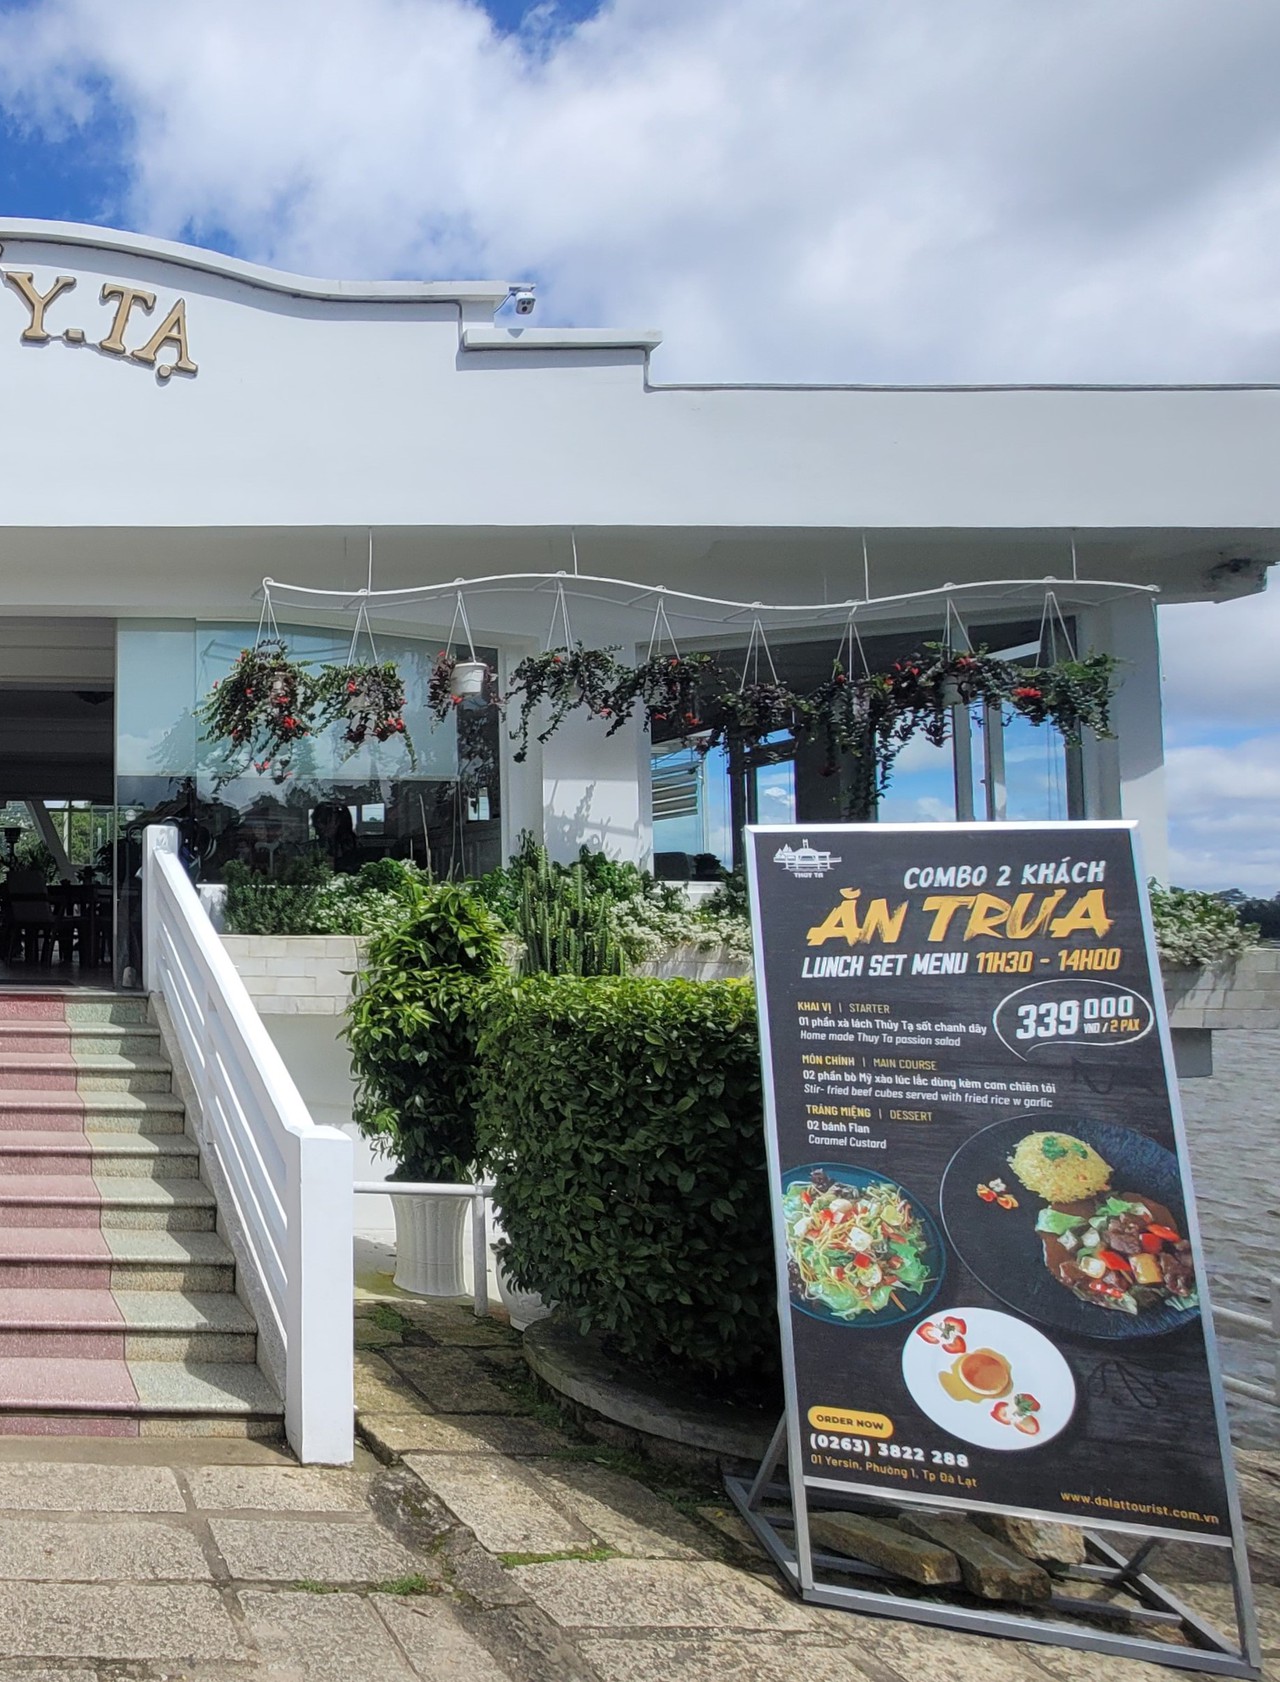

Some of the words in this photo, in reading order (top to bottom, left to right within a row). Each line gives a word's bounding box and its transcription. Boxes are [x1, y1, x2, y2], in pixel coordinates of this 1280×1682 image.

[904, 865, 987, 889] COMBO
[996, 866, 1012, 885] 2
[1021, 857, 1106, 885] KHÁCH
[806, 887, 910, 946] ĂN
[801, 955, 864, 978] LUNCH
[868, 953, 908, 976] SET
[910, 952, 969, 975] MENU
[975, 950, 1034, 973] 11H30
[1058, 948, 1121, 972] 14H00
[797, 1001, 820, 1011] KHAI
[821, 1003, 832, 1014] VỊ
[849, 1003, 890, 1013] STARTER
[1016, 1000, 1080, 1039] 339
[1083, 996, 1133, 1019] 000
[798, 1016, 809, 1026] 01
[837, 1019, 849, 1028] xà
[851, 1019, 873, 1029] lách
[874, 1019, 898, 1032] Thủy
[901, 1021, 914, 1033] Tạ
[916, 1019, 932, 1031] sốt
[934, 1021, 966, 1033] chanh
[968, 1023, 987, 1036] dây
[1084, 1023, 1100, 1034] VND
[1110, 1020, 1118, 1032] 2
[1120, 1019, 1140, 1032] PAX
[800, 1030, 826, 1040] Home
[829, 1032, 854, 1041] made
[857, 1032, 880, 1044] Thuy
[882, 1034, 894, 1043] Ta
[895, 1035, 932, 1045] passion
[935, 1036, 961, 1046] salad
[825, 1054, 855, 1066] CHÍNH
[873, 1058, 896, 1068] MAIN
[899, 1059, 937, 1070] COURSE
[803, 1070, 815, 1079] 02
[844, 1072, 856, 1081] bò
[874, 1074, 893, 1084] xào
[895, 1074, 910, 1085] lúc
[931, 1077, 956, 1089] dùng
[959, 1078, 981, 1088] kèm
[1009, 1081, 1039, 1092] chiên
[804, 1084, 825, 1093] Stir-
[827, 1085, 849, 1095] fried
[851, 1086, 872, 1096] beef
[874, 1088, 904, 1098] cubes
[905, 1091, 938, 1100] served
[941, 1092, 962, 1102] with
[964, 1093, 988, 1104] fried
[990, 1095, 1010, 1105] rice
[1024, 1097, 1053, 1109] garlic
[806, 1103, 838, 1116] TRÁNG
[840, 1105, 871, 1119] MIỆNG
[889, 1109, 933, 1121] DESSERT
[807, 1120, 819, 1130] 02
[821, 1121, 846, 1132] bánh
[848, 1122, 870, 1134] Flan
[808, 1134, 847, 1146] Caramel
[849, 1137, 887, 1149] Custard
[816, 1414, 853, 1426] ORDER
[857, 1420, 884, 1430] NOW
[809, 1433, 870, 1457] (0263)
[877, 1442, 925, 1462] 3822
[930, 1450, 969, 1468] 288
[811, 1454, 822, 1465] 01
[922, 1470, 936, 1482] Tp
[940, 1471, 955, 1484] Đà
[957, 1475, 978, 1489] Lạt
[1061, 1491, 1219, 1524] www.dalattourist.com.vn
